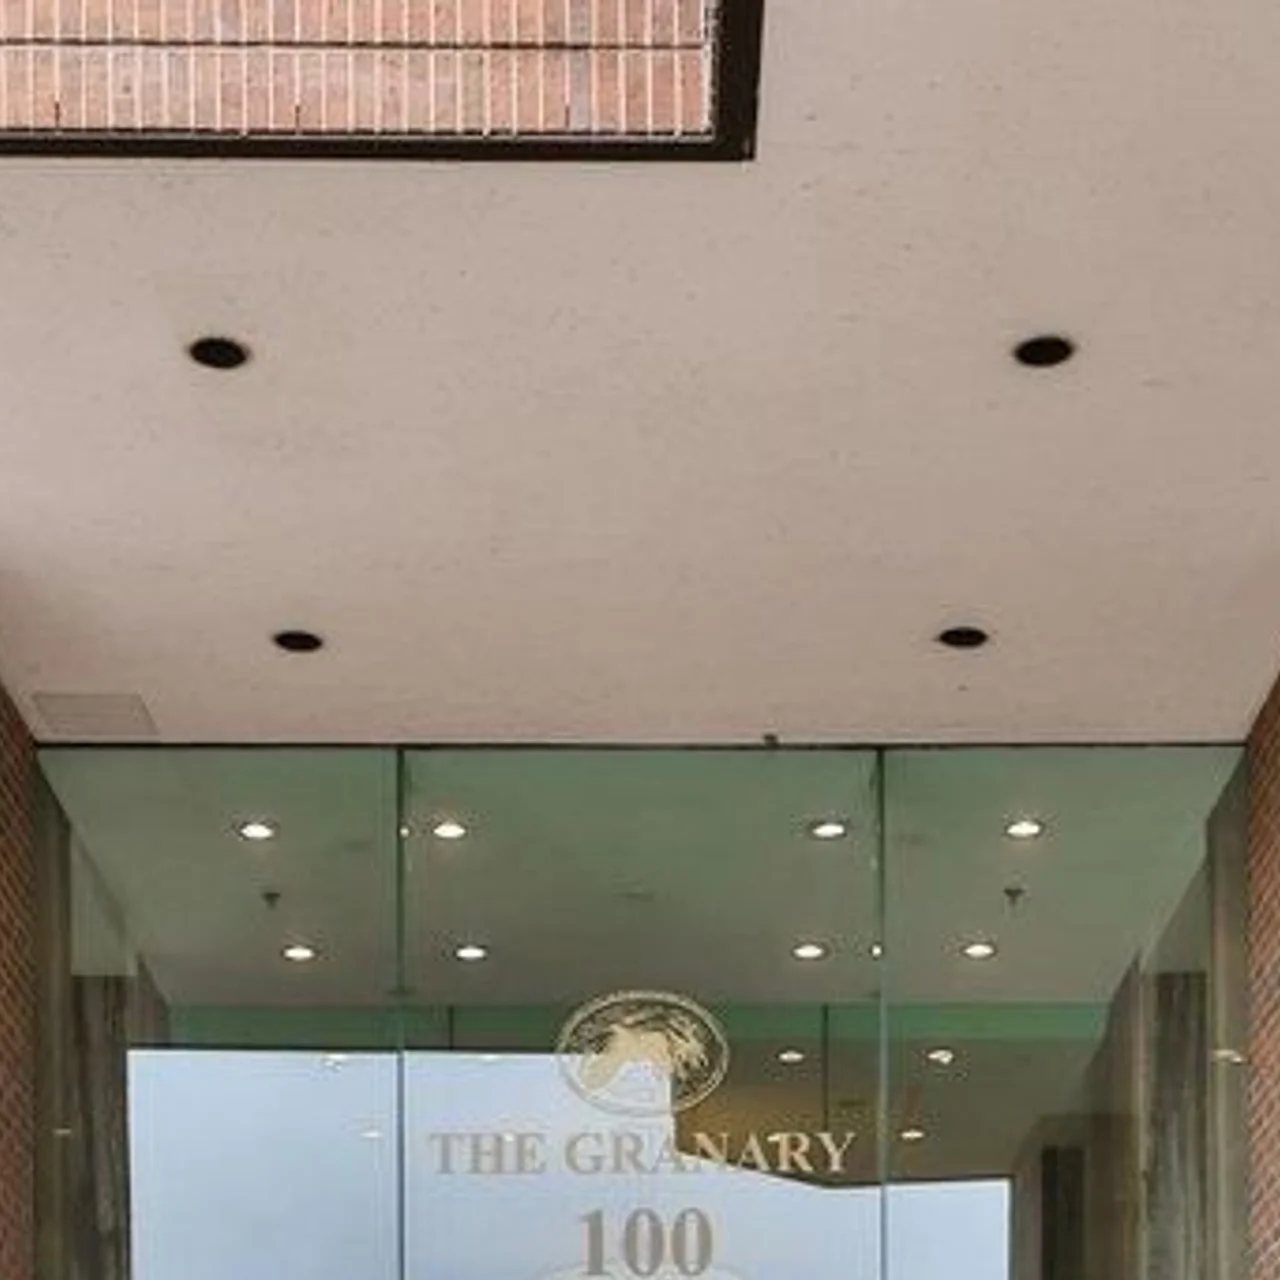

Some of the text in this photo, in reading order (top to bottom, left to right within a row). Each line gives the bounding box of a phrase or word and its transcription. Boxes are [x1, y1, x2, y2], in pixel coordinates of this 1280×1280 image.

[430, 1130, 857, 1176] THE GRANARY
[578, 1205, 714, 1279] 100
